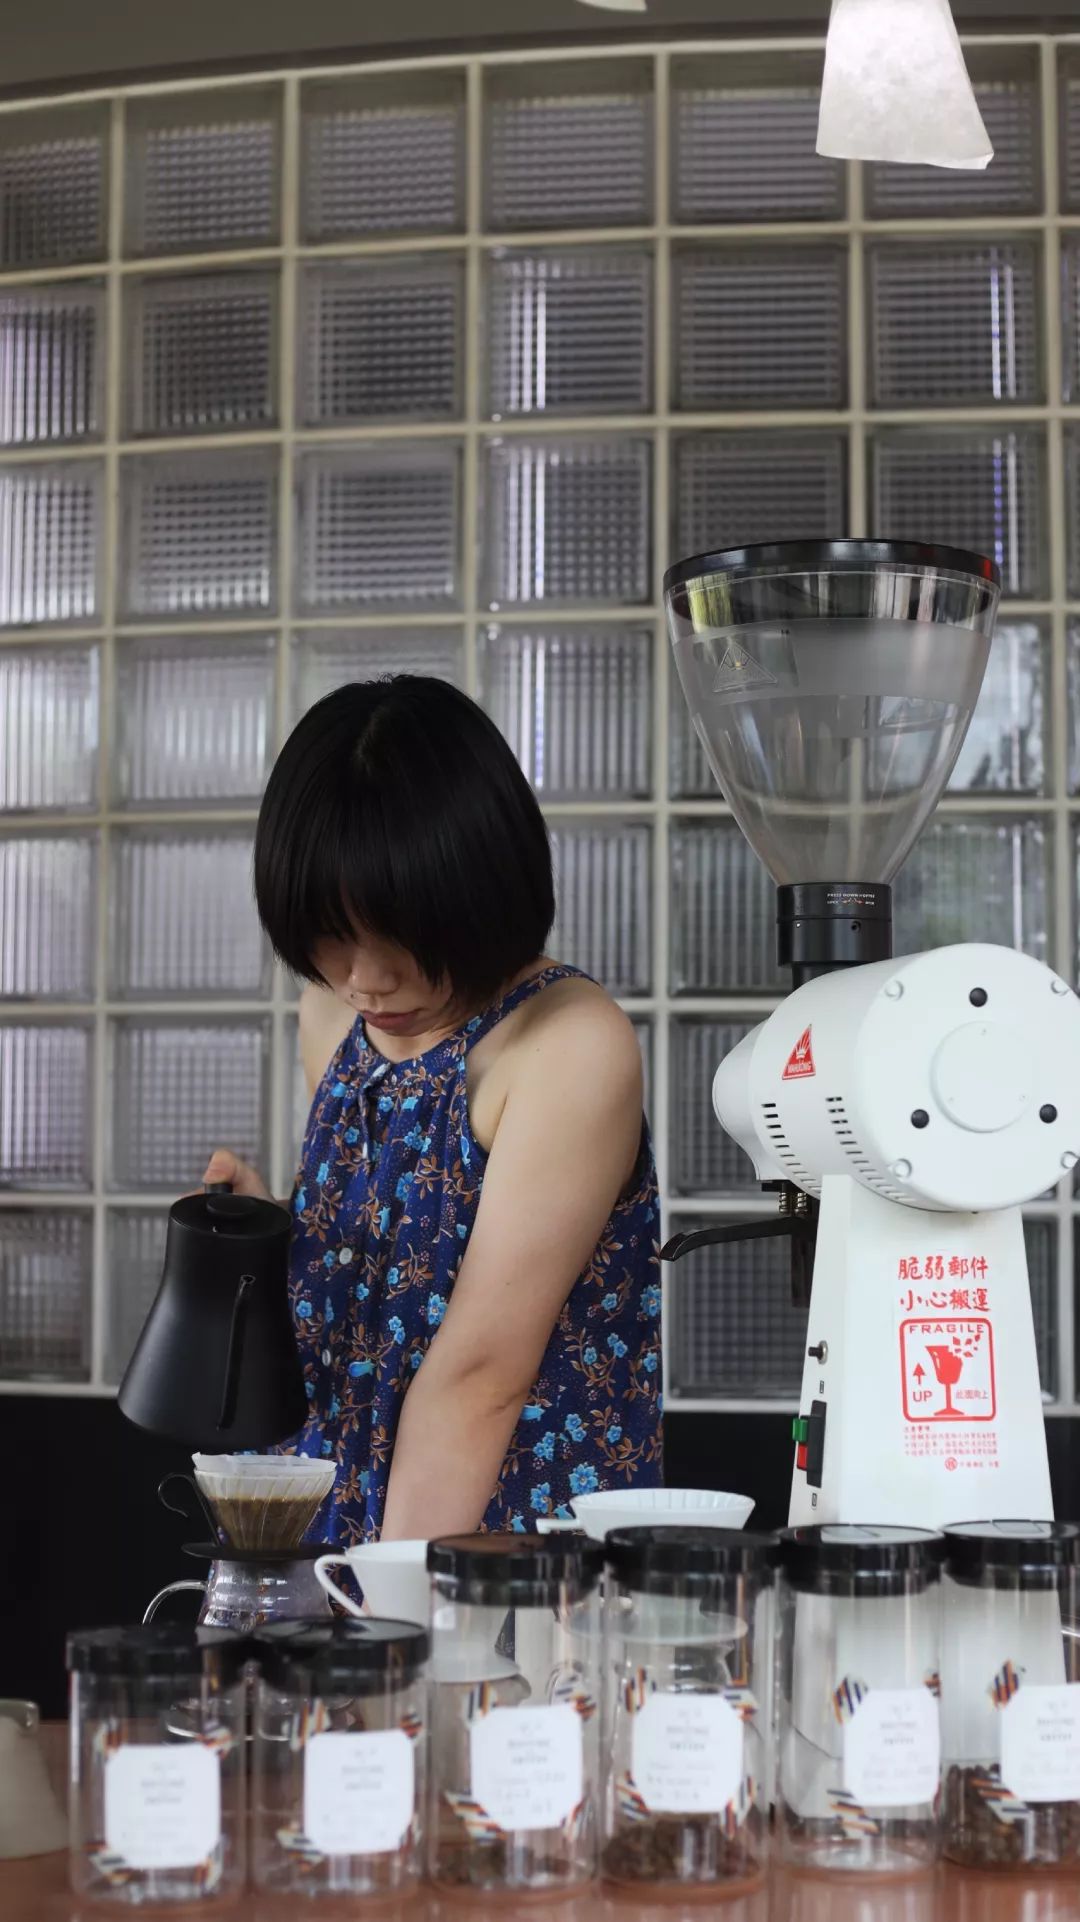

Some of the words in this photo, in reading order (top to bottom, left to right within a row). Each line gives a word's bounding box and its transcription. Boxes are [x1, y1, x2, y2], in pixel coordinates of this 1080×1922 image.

[898, 1255, 988, 1280] 脆弱郵件
[899, 1288, 990, 1312] 小心搬運
[909, 1324, 984, 1334] FRAGILE
[913, 1390, 933, 1402] UP
